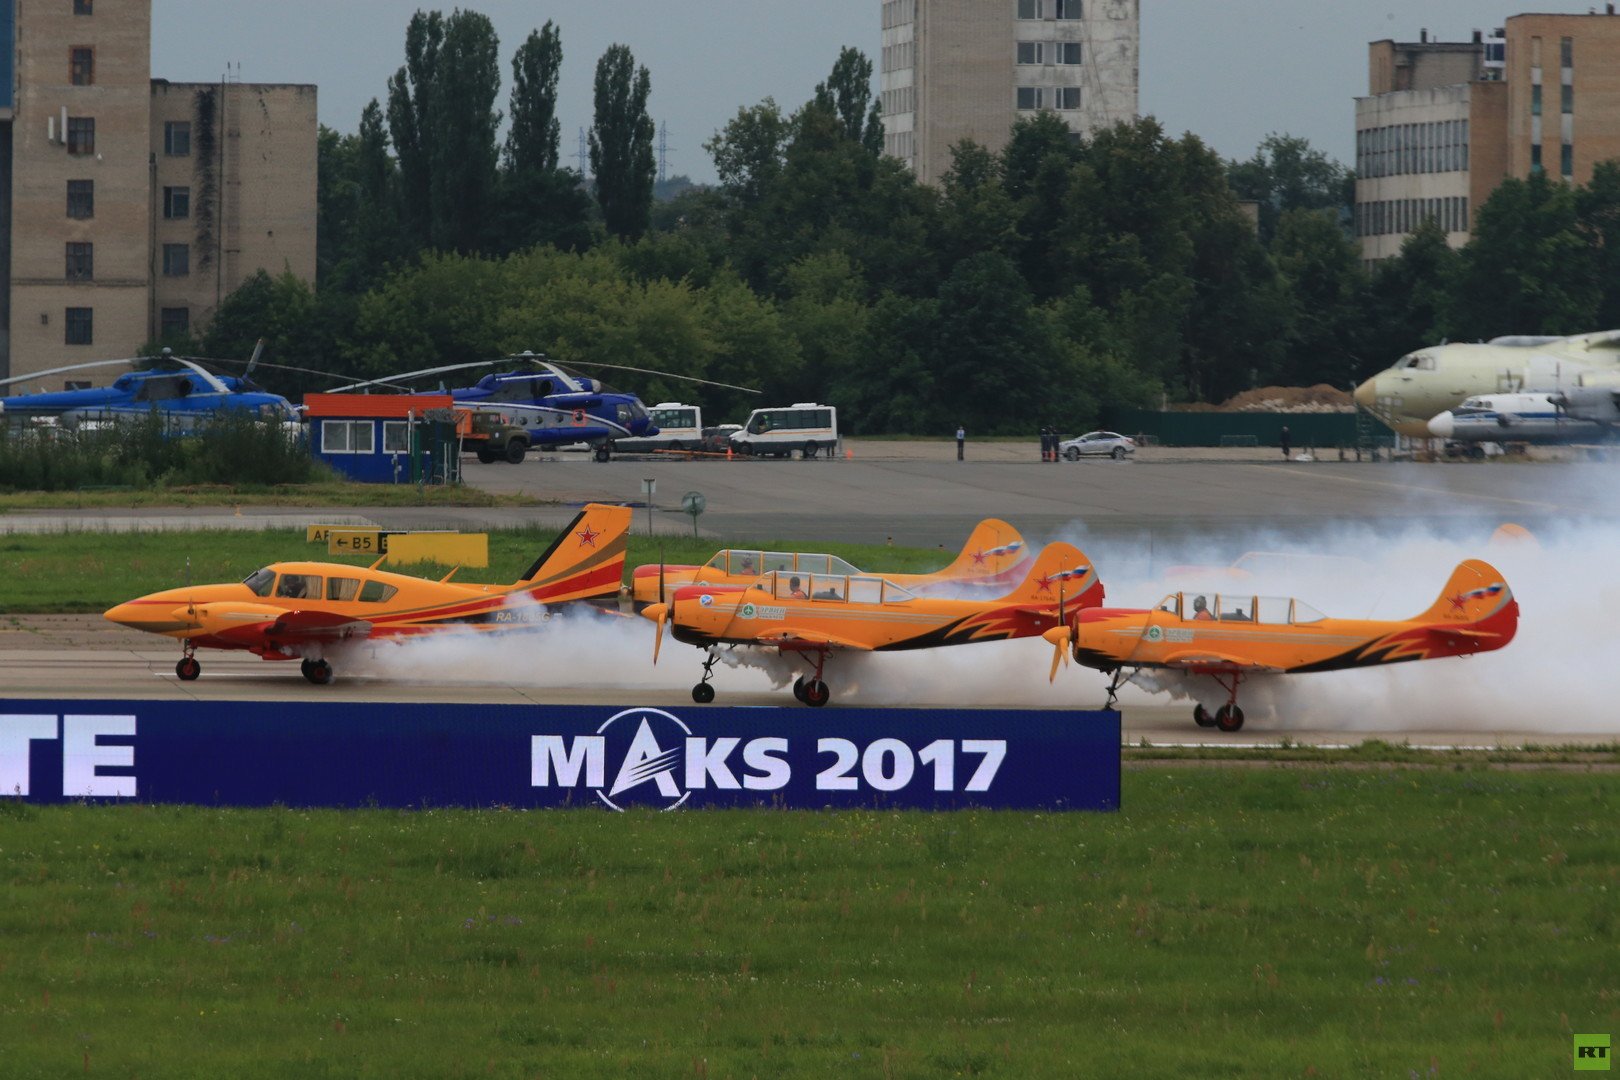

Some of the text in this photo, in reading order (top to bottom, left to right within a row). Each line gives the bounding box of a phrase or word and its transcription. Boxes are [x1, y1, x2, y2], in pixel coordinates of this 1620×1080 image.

[352, 537, 371, 549] B5
[0, 714, 137, 797] TE
[531, 714, 1007, 797] MAKS 2017
